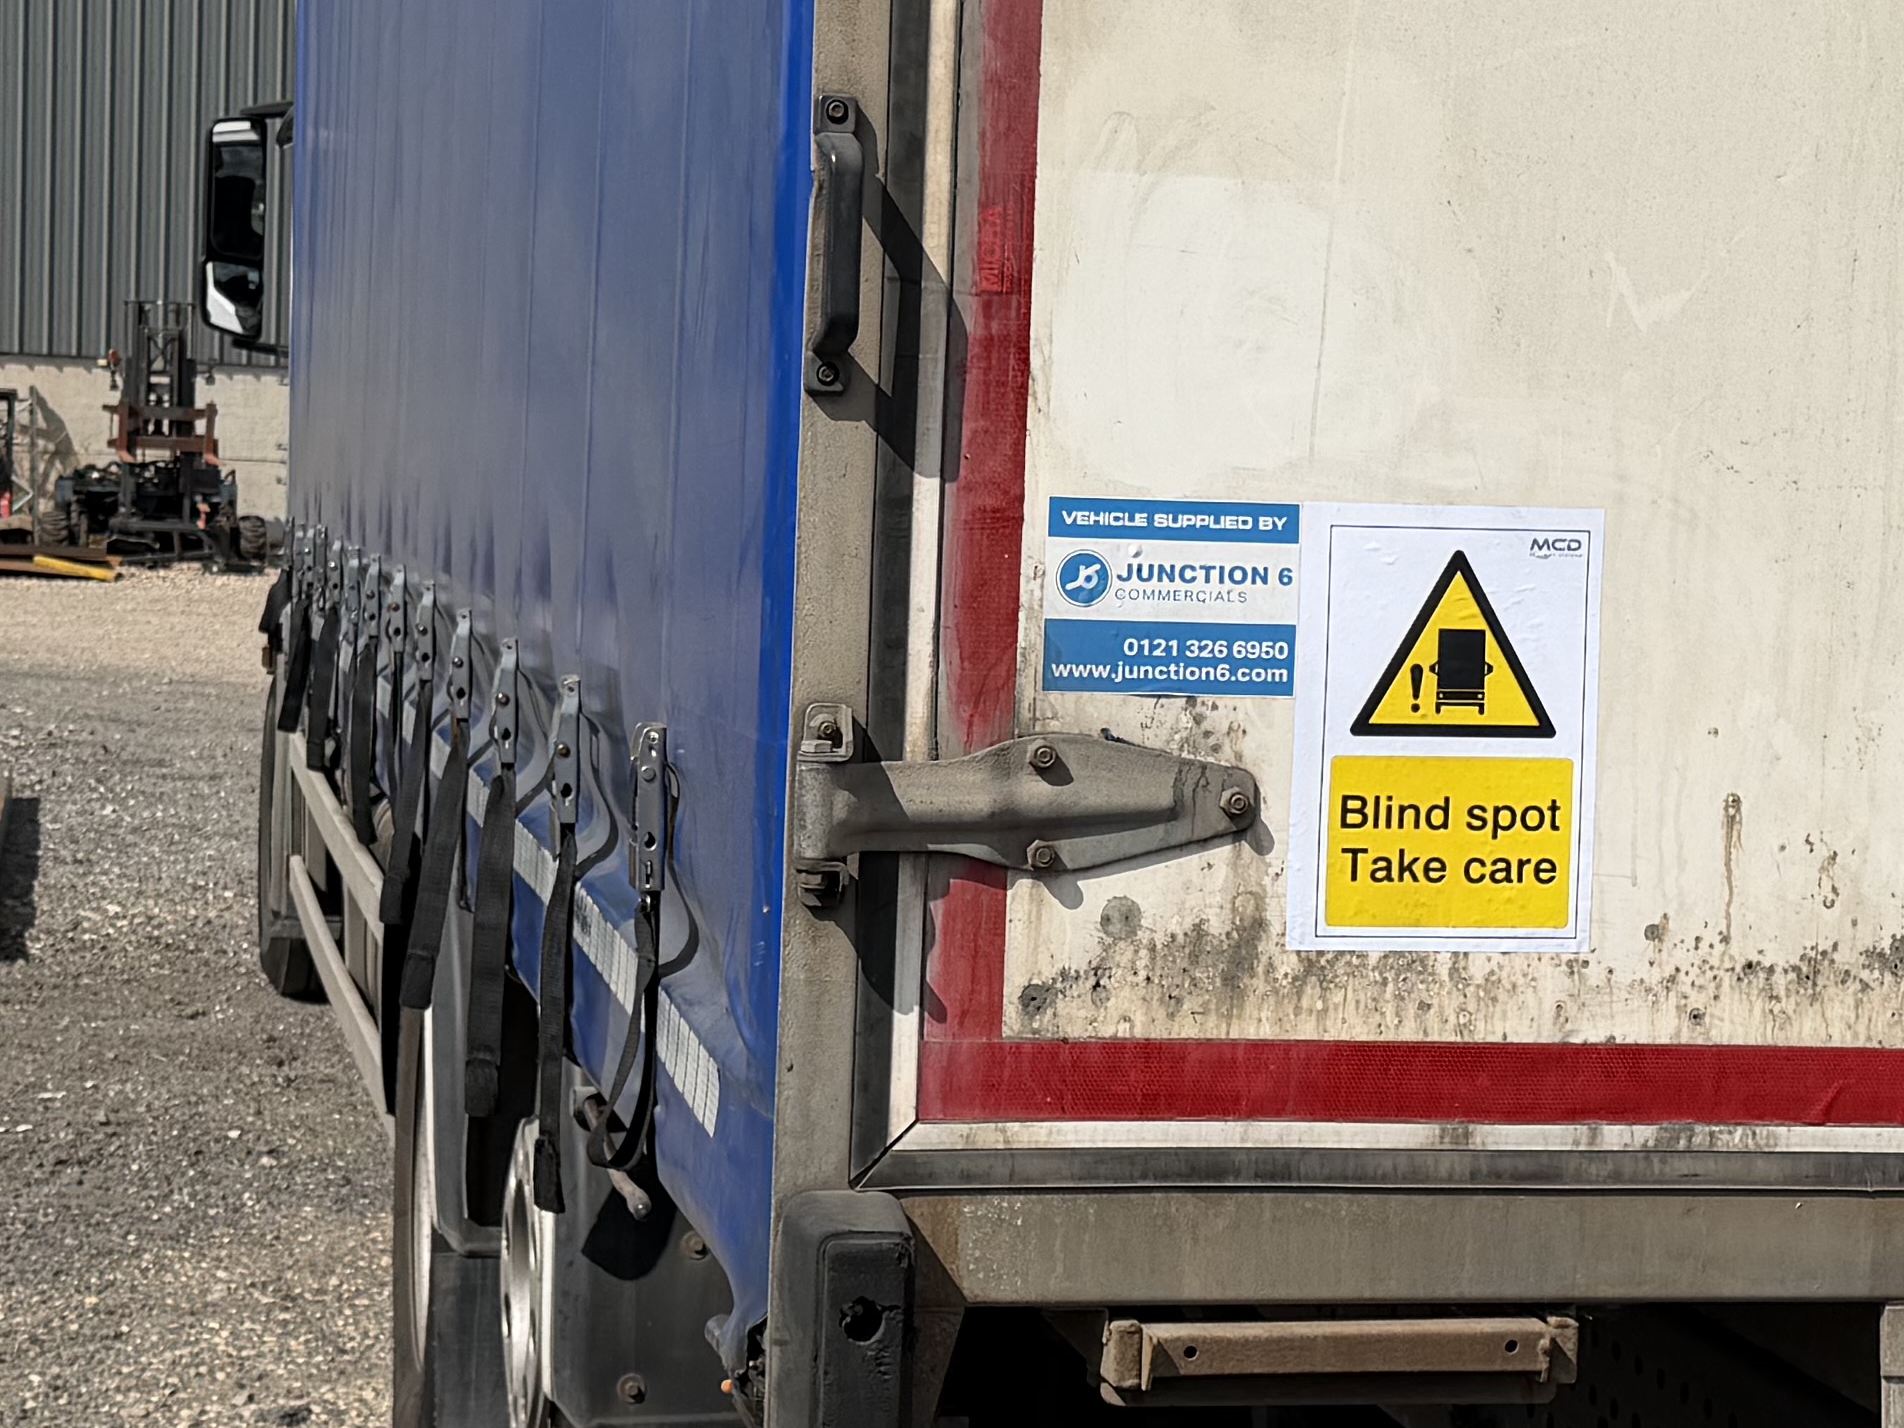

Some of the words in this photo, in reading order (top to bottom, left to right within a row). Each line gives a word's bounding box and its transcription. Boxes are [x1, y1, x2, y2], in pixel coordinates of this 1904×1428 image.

[1061, 510, 1148, 527] VEHICLE
[1153, 513, 1253, 530] SUPPLIED
[1258, 516, 1287, 531] BY
[1529, 537, 1582, 552] MCD
[1116, 563, 1269, 586] JUNCTION
[1277, 567, 1294, 586] 6
[1114, 587, 1248, 604] COMMERCIALS
[1123, 638, 1178, 657] 0121
[1185, 640, 1228, 658] 326
[1232, 641, 1289, 659] 6950
[1051, 660, 1289, 684] www.junction6.com
[1340, 794, 1451, 830] Blind
[1465, 798, 1562, 840] spot
[1341, 847, 1447, 884] Take
[1463, 857, 1558, 885] care
